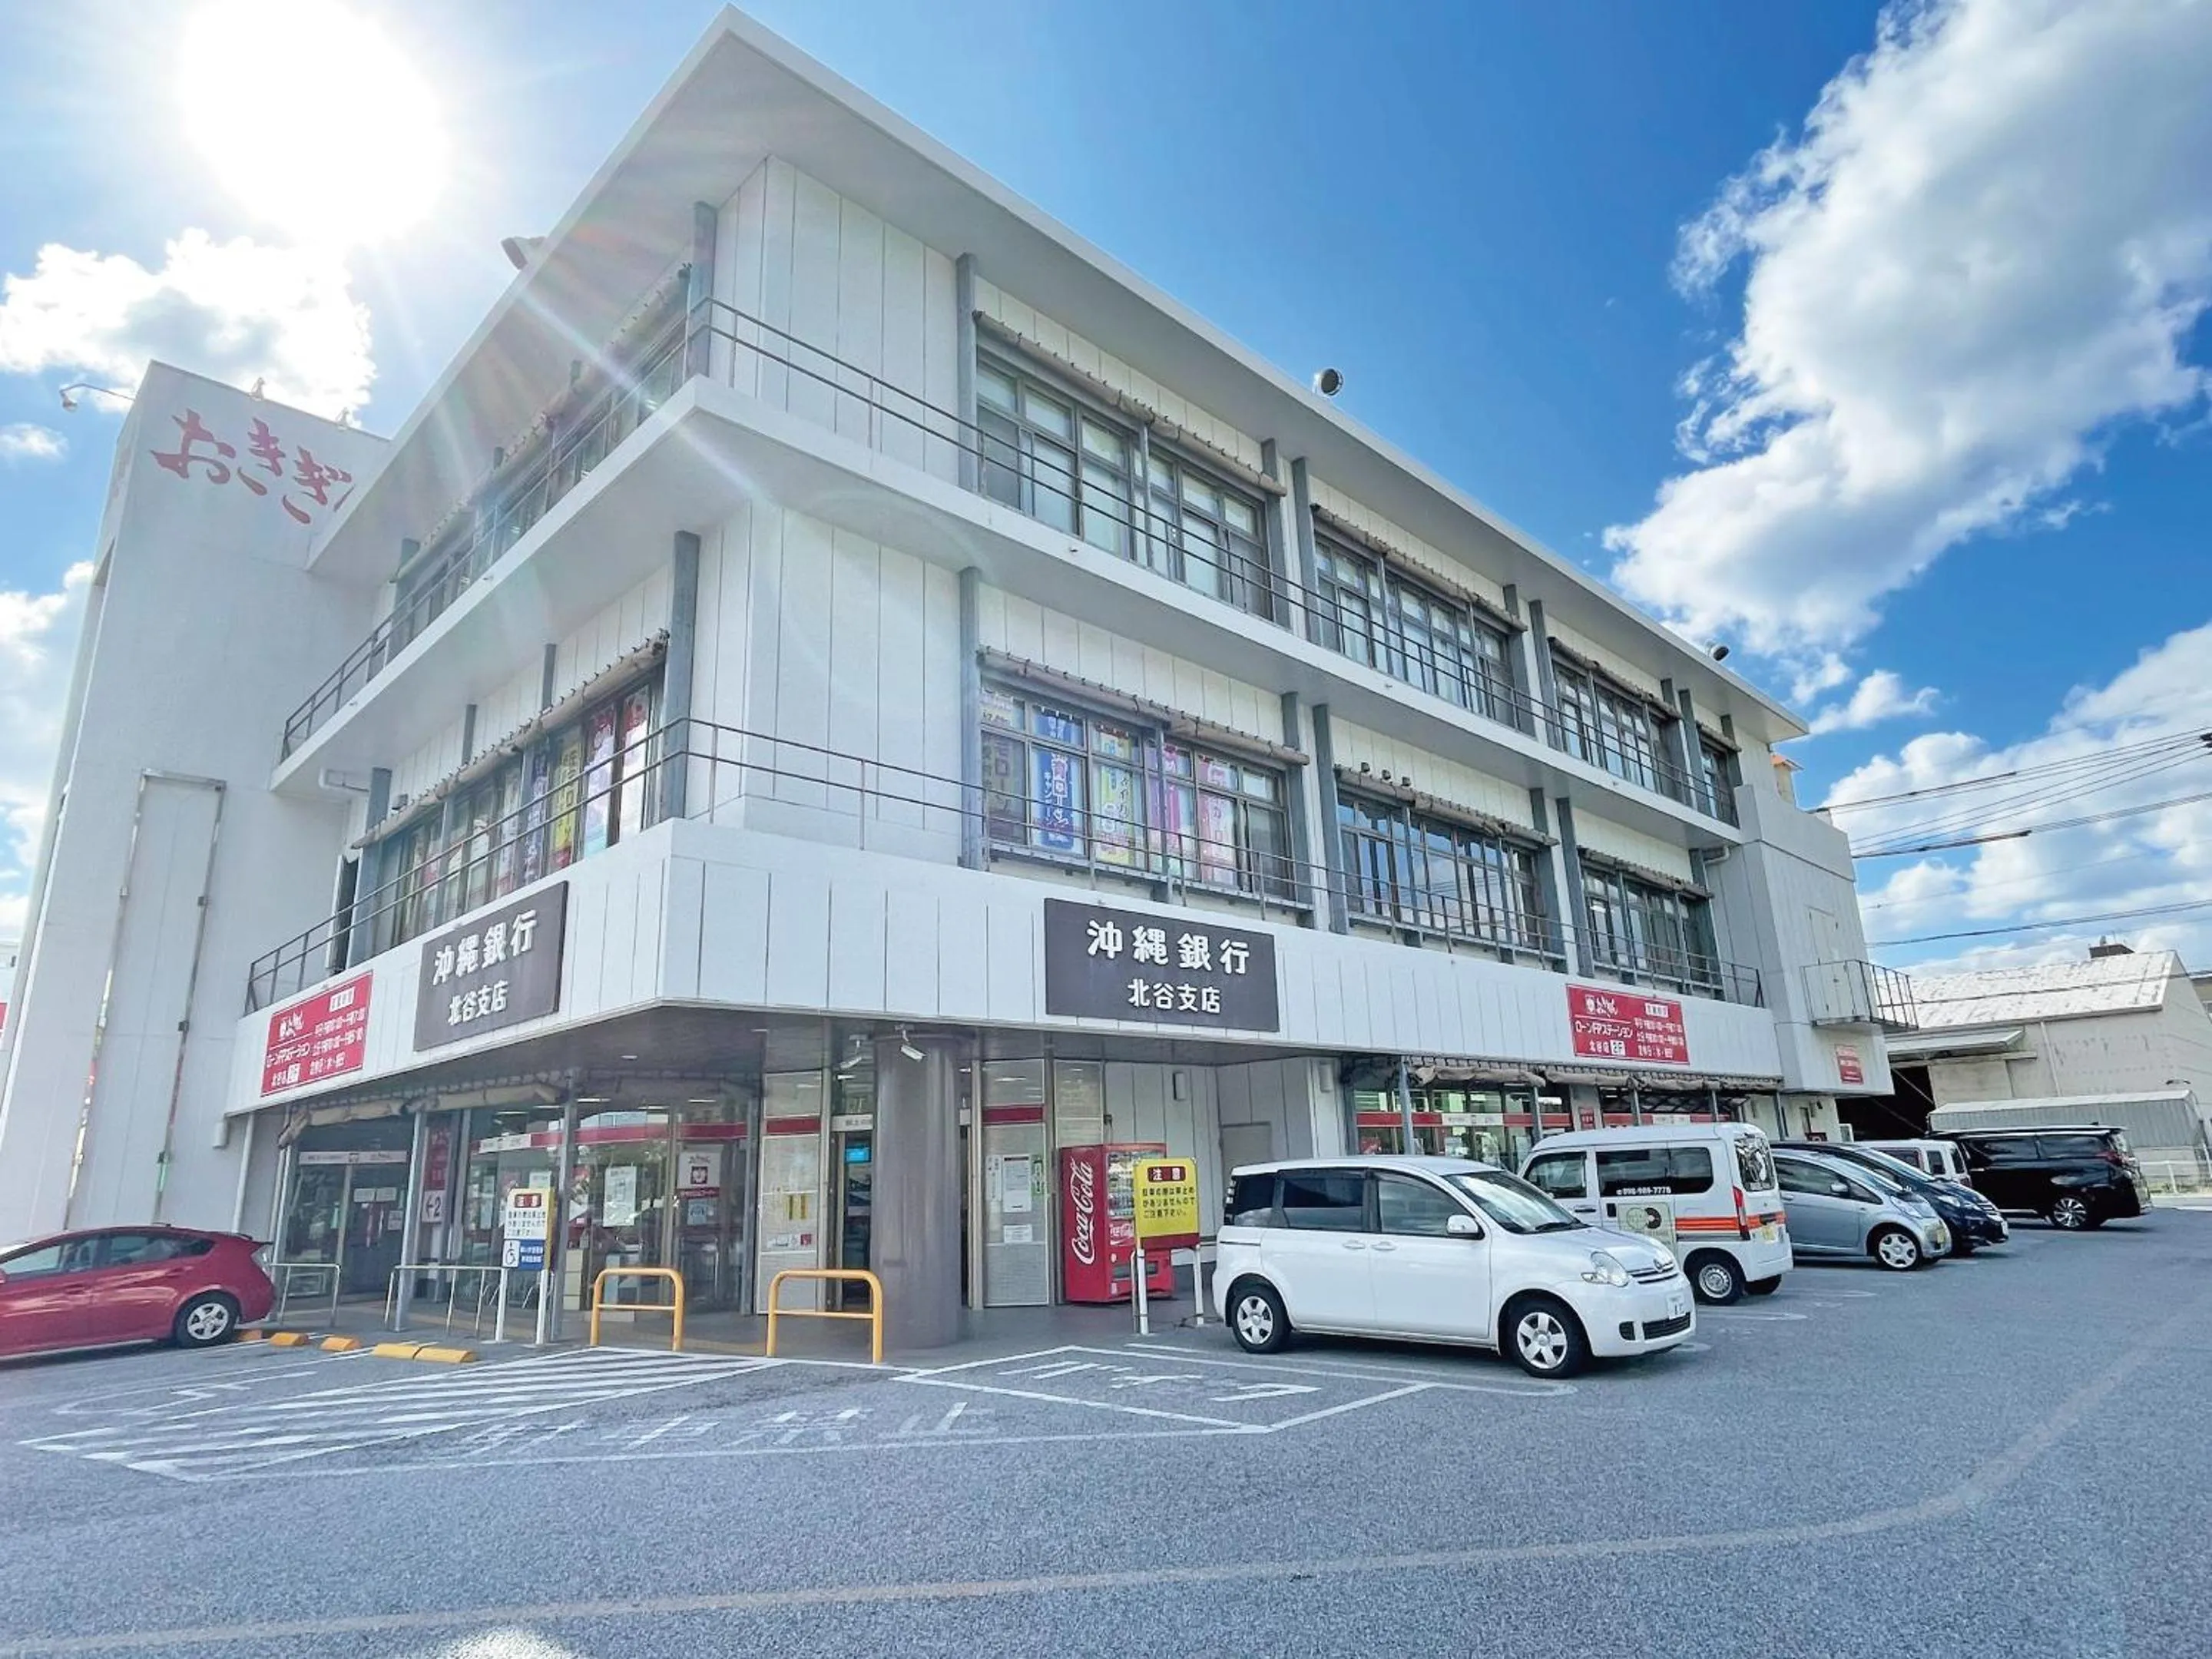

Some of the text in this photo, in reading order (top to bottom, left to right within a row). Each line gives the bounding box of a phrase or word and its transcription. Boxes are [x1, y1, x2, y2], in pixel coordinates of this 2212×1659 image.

[150, 408, 355, 525] おきぎ
[432, 909, 538, 986] 沖縄銀行
[1086, 919, 1250, 975] 沖縄銀行
[447, 979, 509, 1026] 北谷支店
[1127, 978, 1221, 1015] 北谷支店
[1070, 1156, 1095, 1265] Coca-Cola
